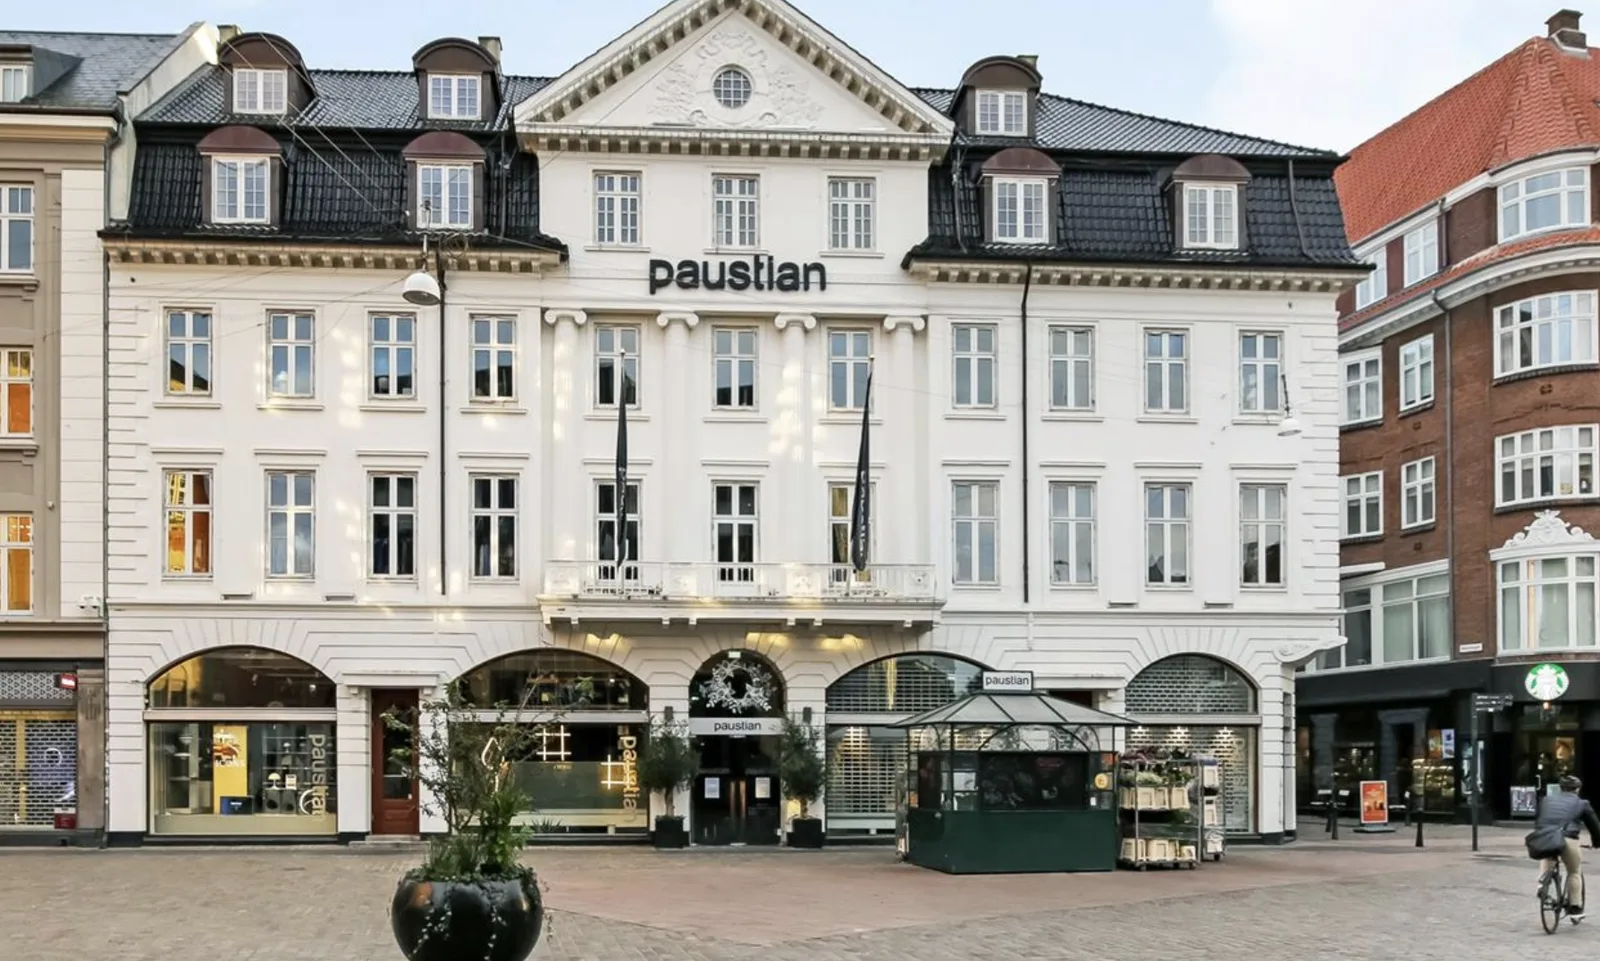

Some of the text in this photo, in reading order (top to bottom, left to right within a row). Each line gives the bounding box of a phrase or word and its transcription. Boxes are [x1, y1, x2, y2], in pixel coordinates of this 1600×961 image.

[649, 254, 827, 295] paustian
[985, 675, 1030, 686] paustian
[713, 721, 762, 732] paustian
